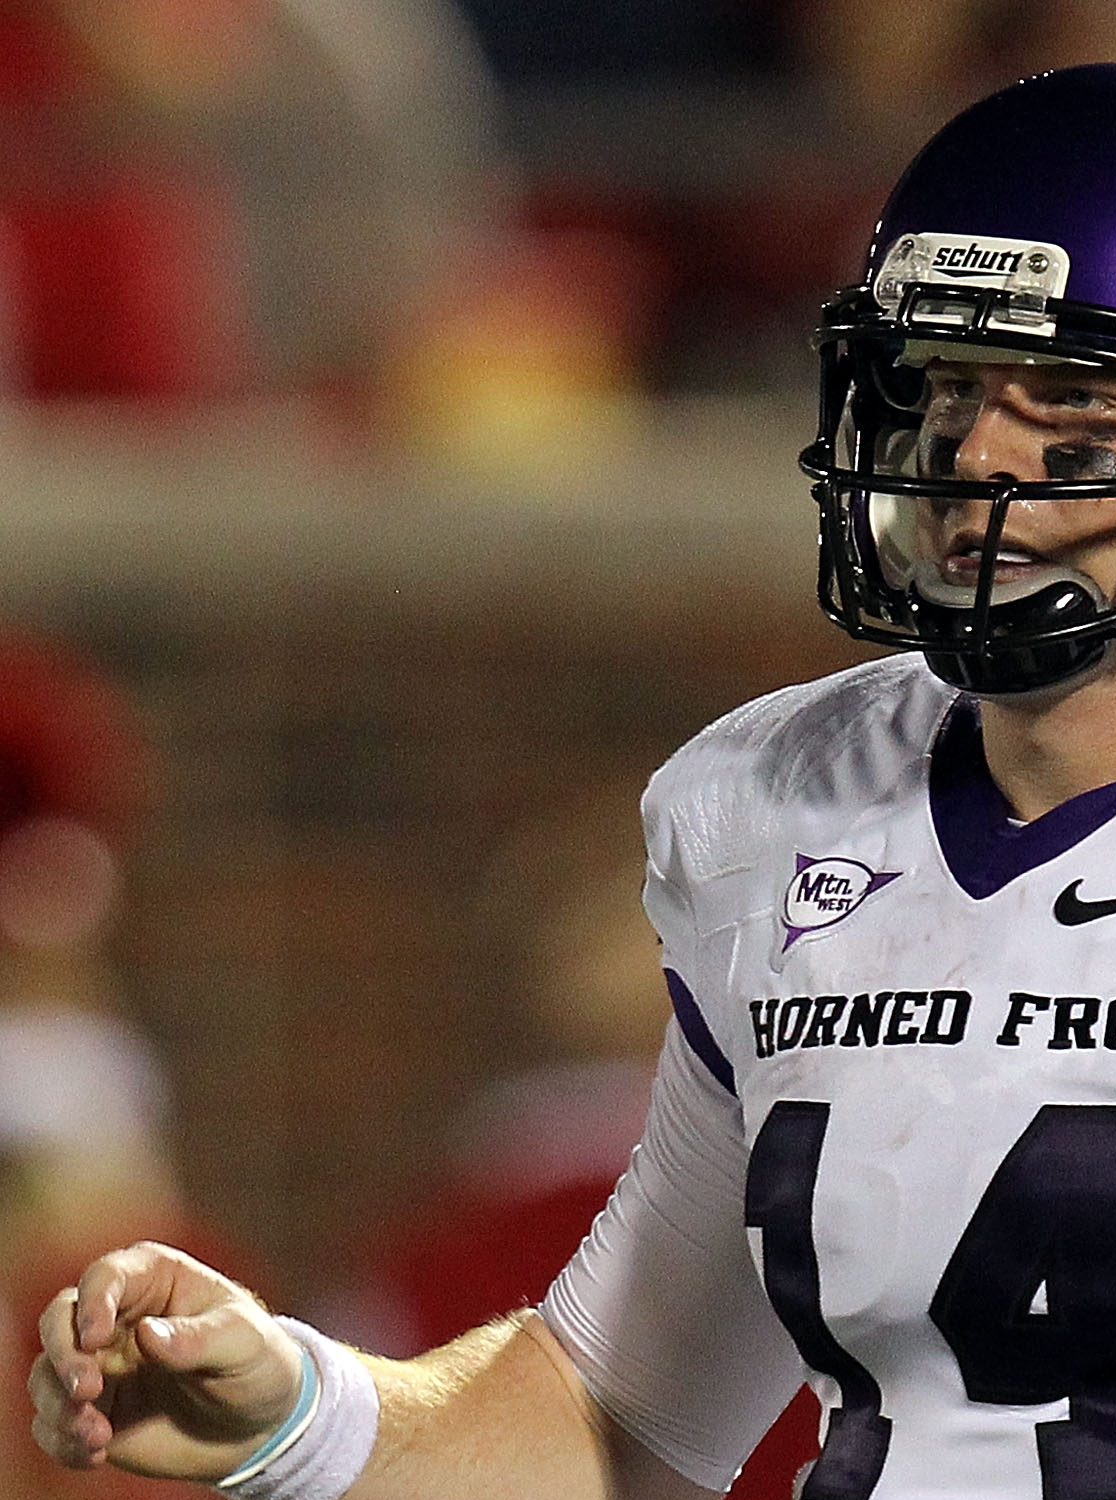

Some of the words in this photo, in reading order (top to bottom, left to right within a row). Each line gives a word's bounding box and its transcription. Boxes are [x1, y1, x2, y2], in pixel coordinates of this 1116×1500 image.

[932, 242, 1024, 274] schutt
[817, 898, 853, 911] WEST
[748, 989, 973, 1060] HORNED
